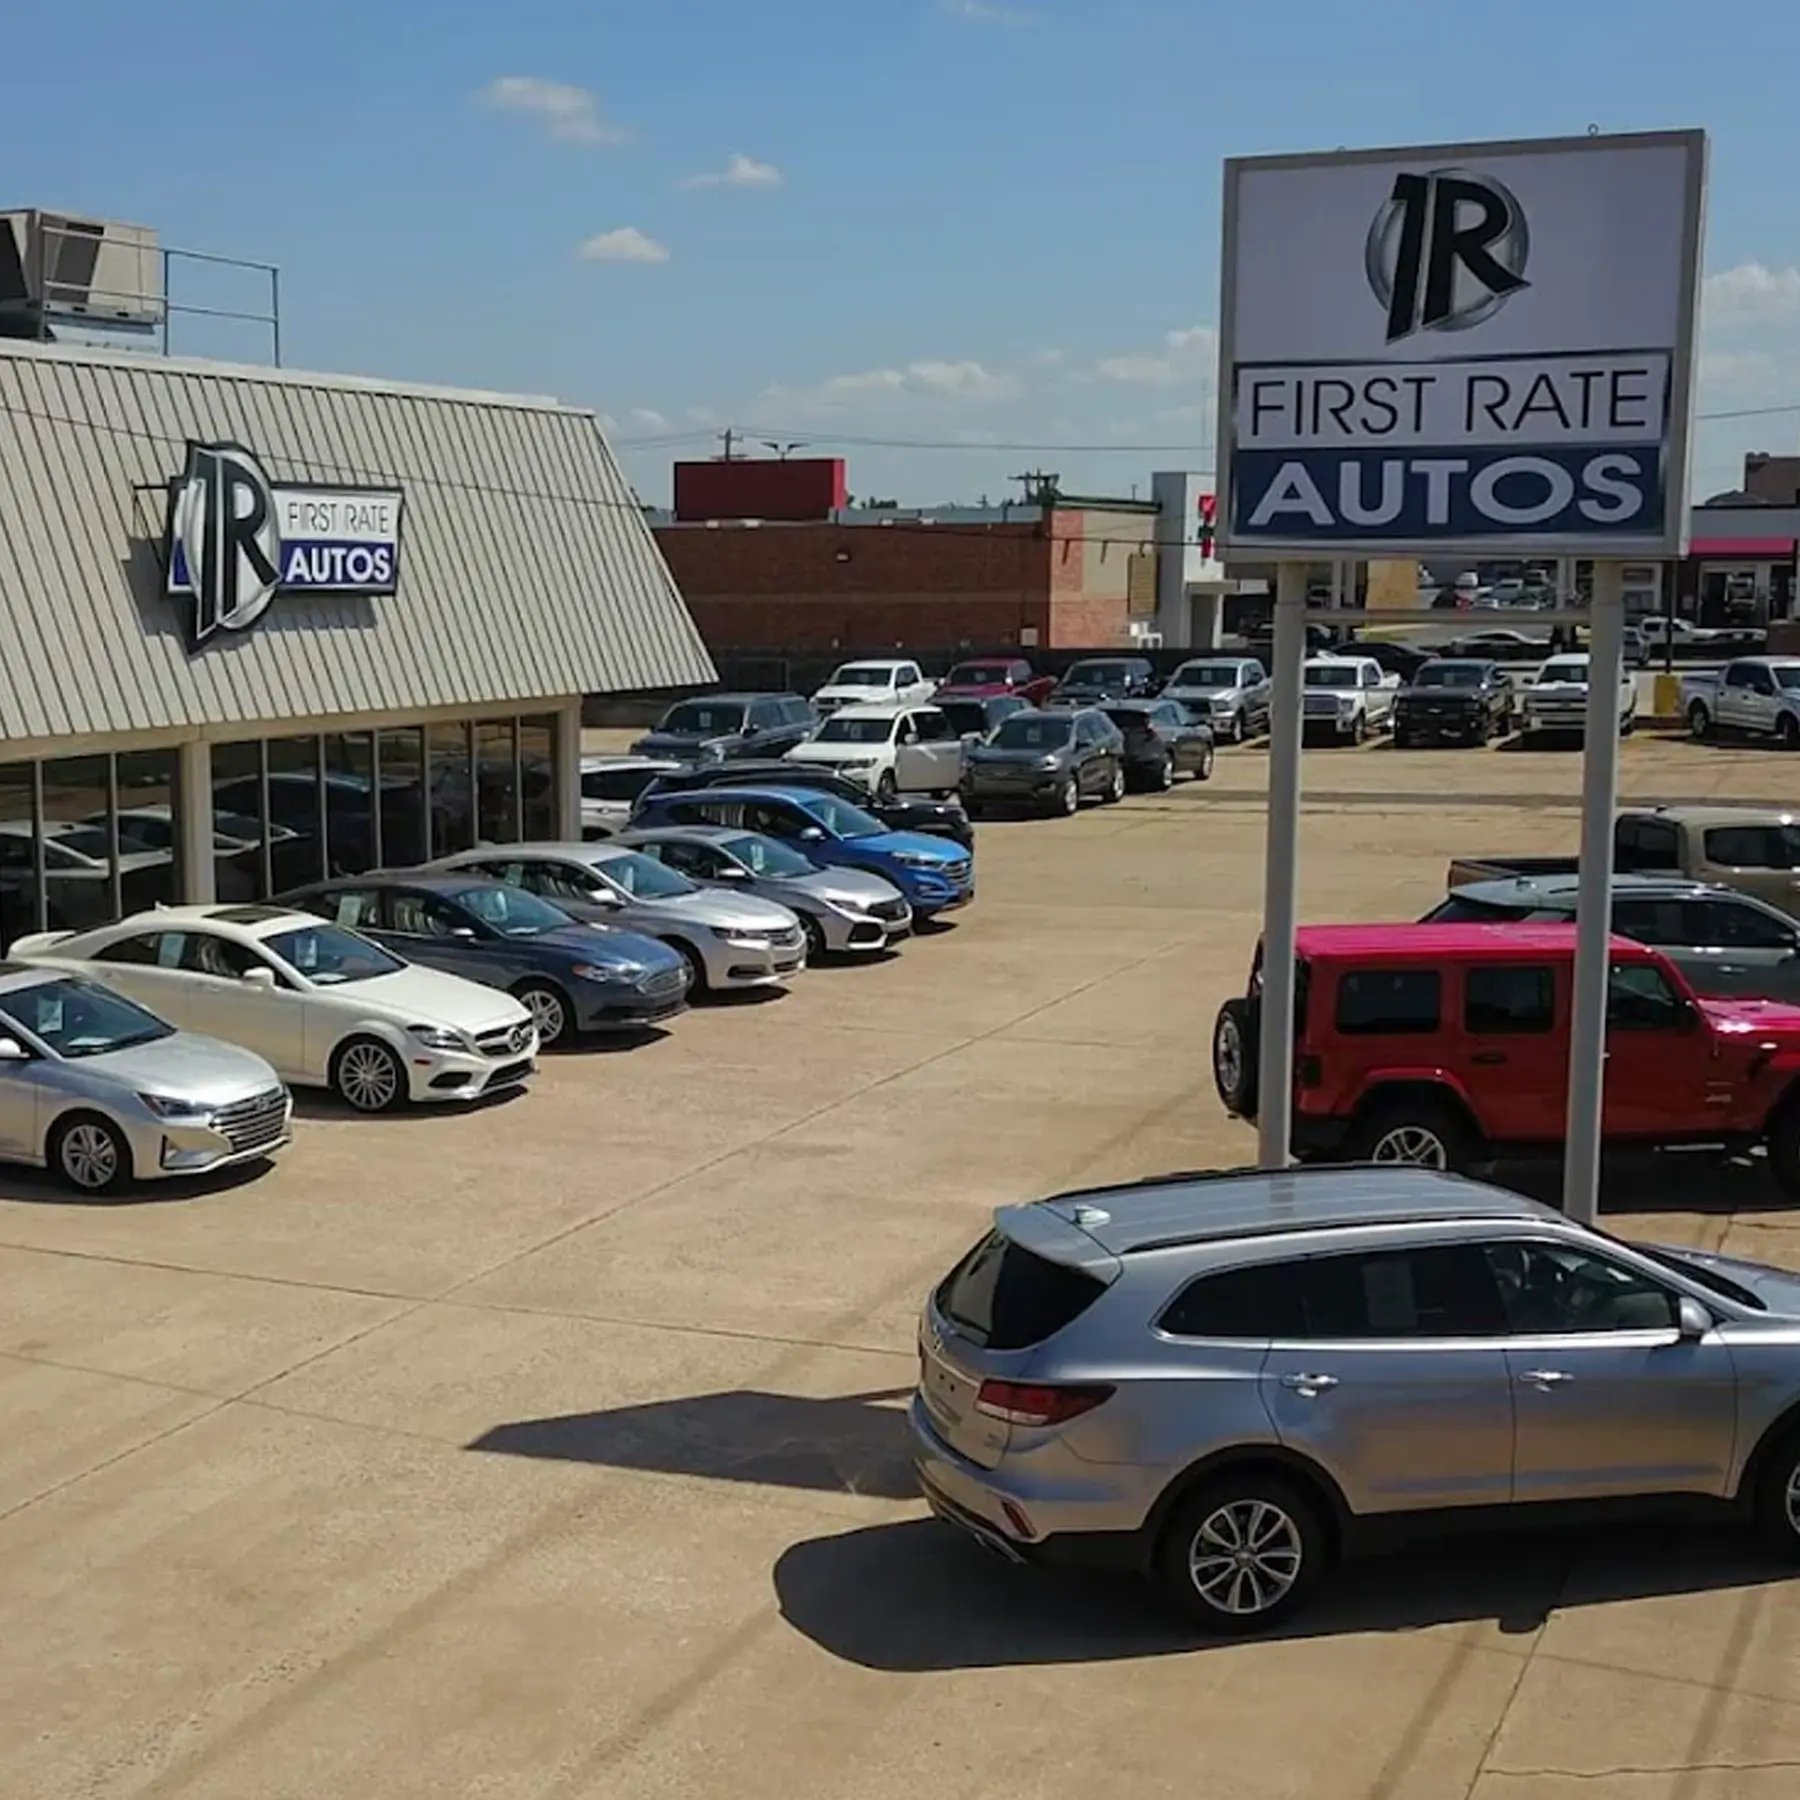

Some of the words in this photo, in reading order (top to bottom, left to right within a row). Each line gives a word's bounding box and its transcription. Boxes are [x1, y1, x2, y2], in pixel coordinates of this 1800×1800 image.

[1252, 376, 1436, 436] FIRST
[1465, 369, 1649, 433] RATE
[1248, 454, 1644, 527] AUTOS
[287, 502, 337, 532] FIRST
[344, 504, 389, 534] RATE
[285, 547, 391, 583] AUTOS
